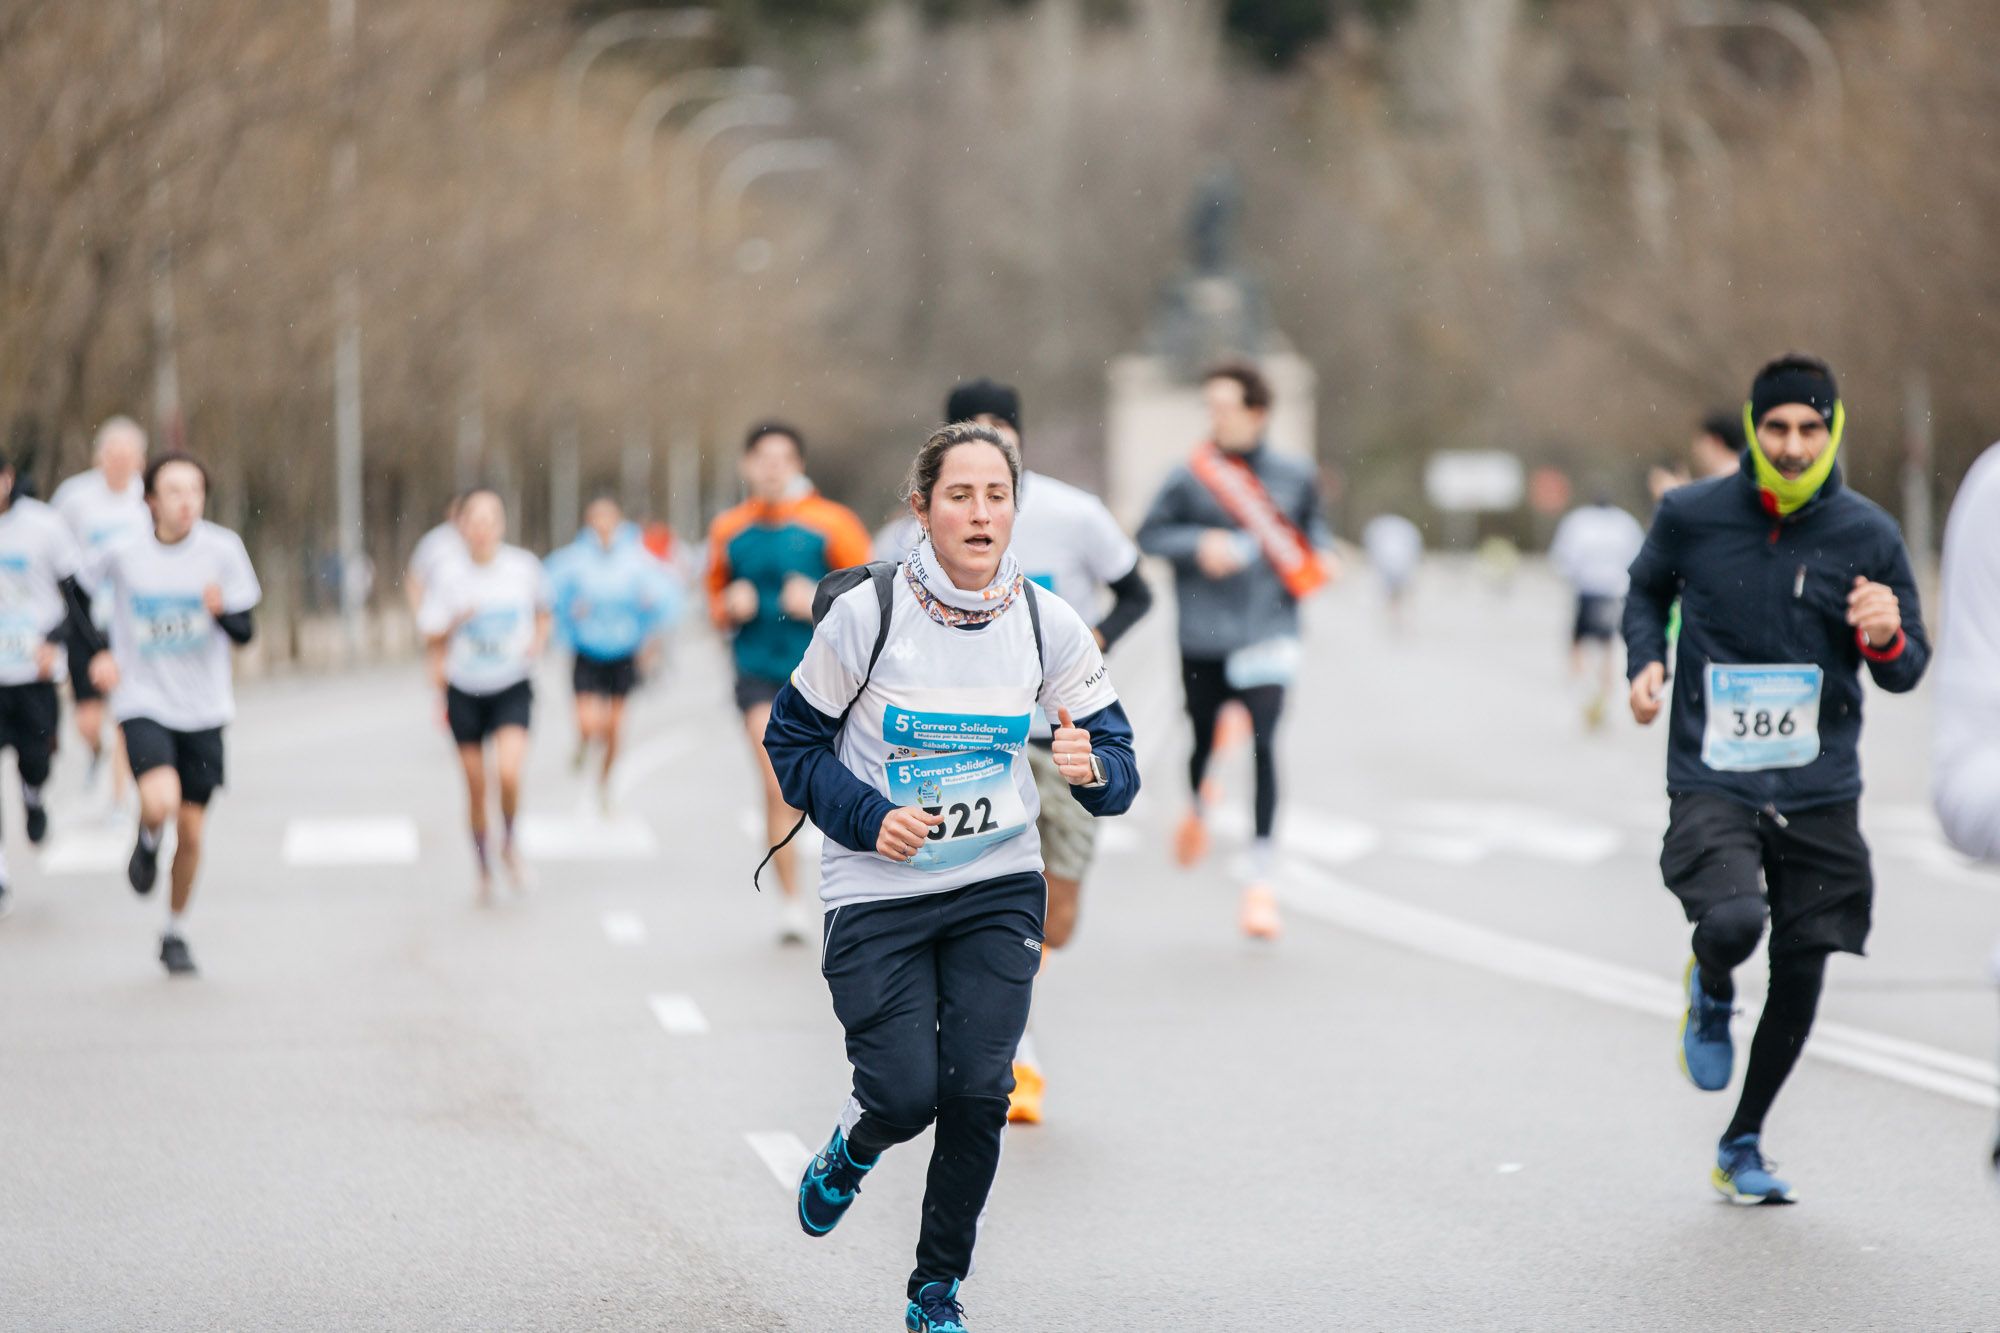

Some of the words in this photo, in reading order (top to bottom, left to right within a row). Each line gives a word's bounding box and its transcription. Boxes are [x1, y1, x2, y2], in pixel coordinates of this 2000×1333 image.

[912, 720, 957, 731] Carrera
[960, 722, 1008, 734] Solidaria
[1733, 709, 1795, 736] 386
[922, 741, 950, 750] Sábado
[913, 767, 953, 778] Carrera
[955, 756, 993, 773] Solidaria
[922, 797, 999, 841] 322
